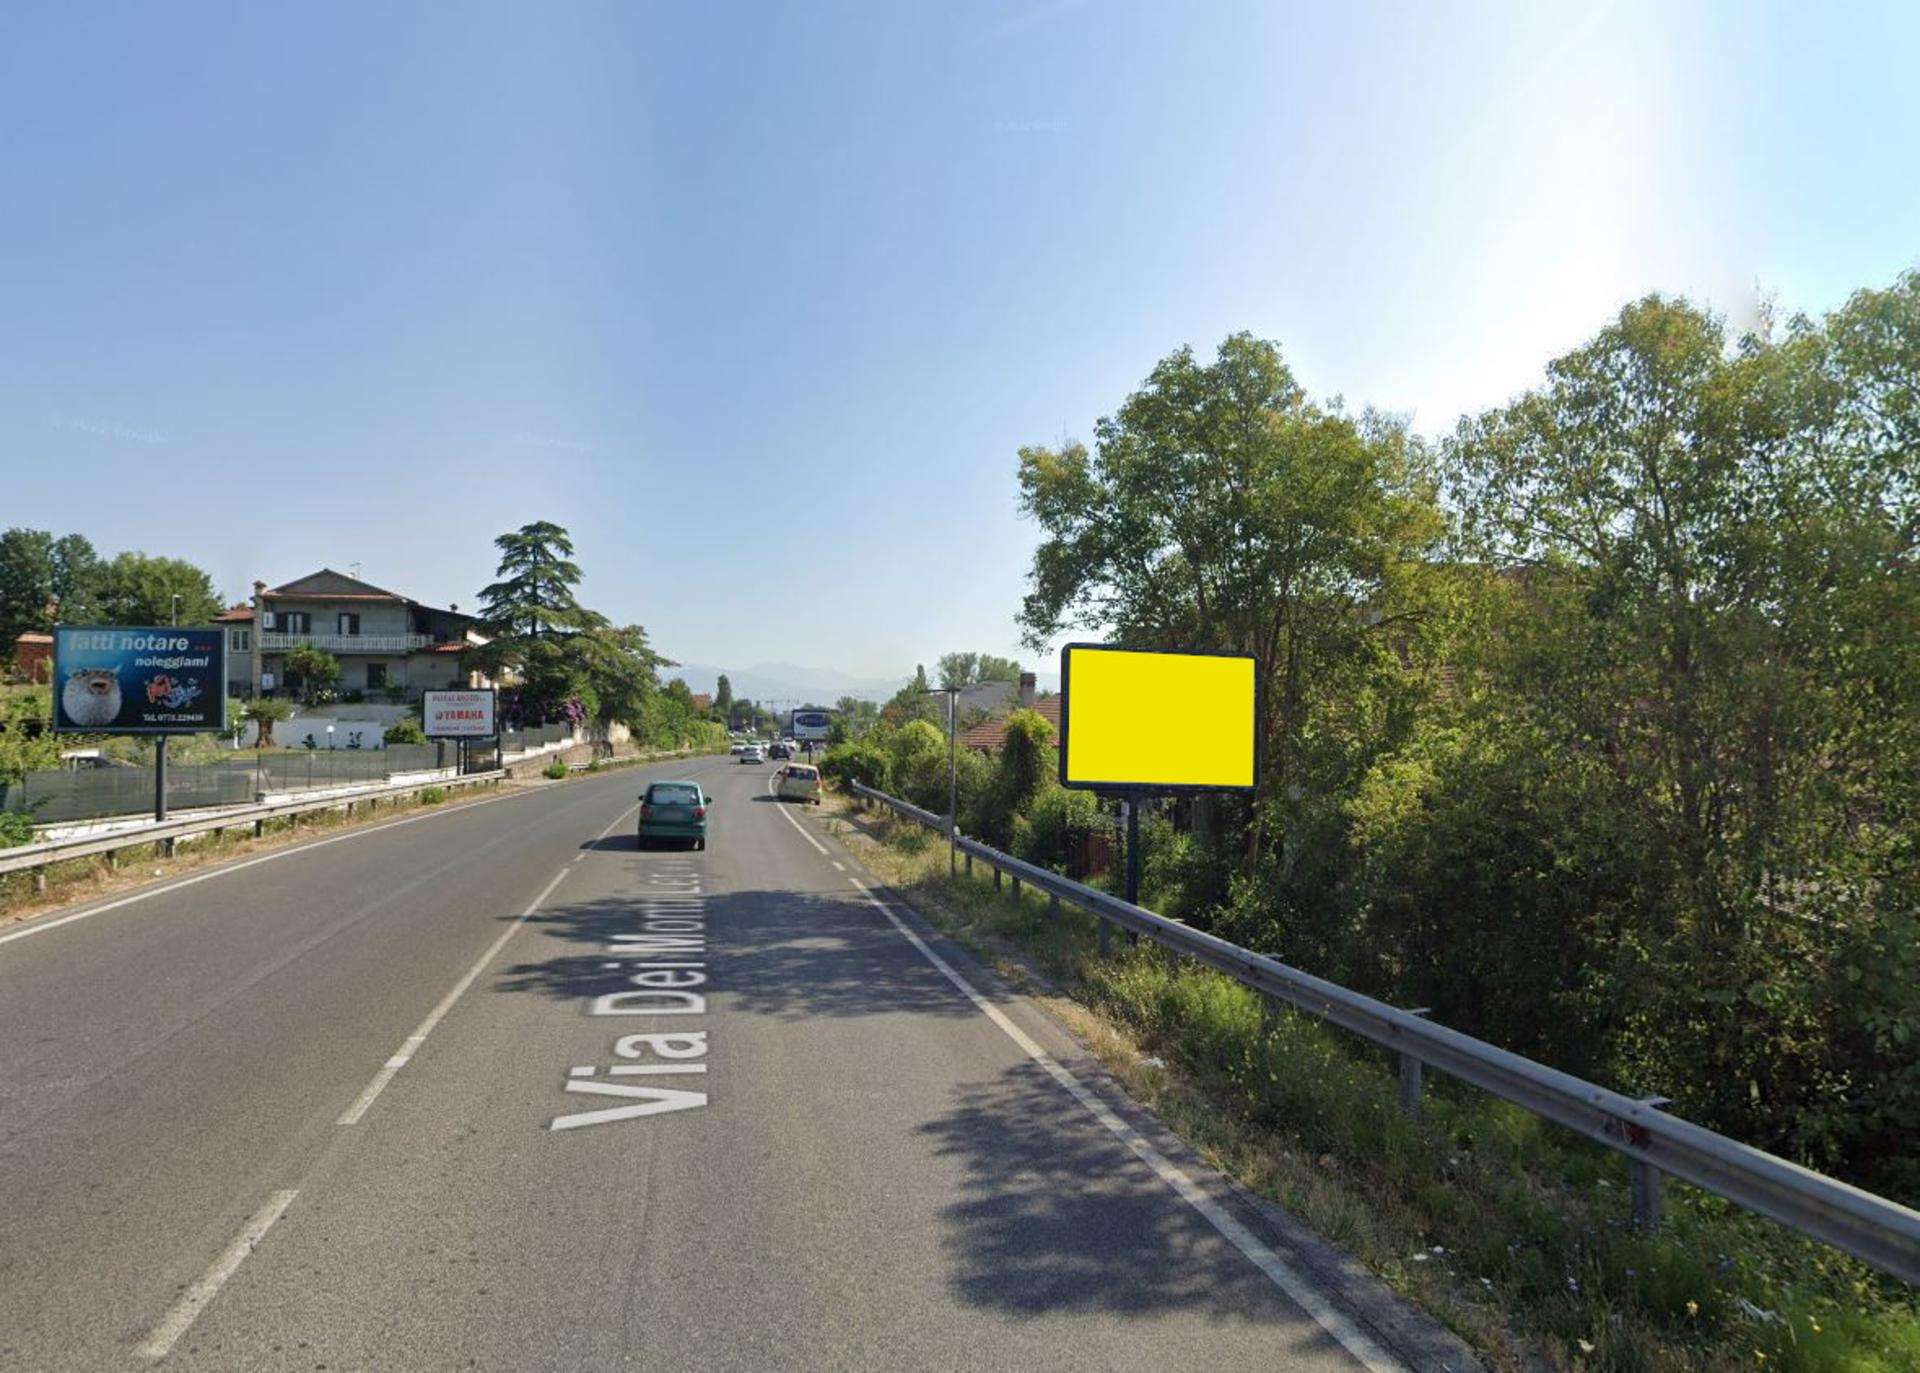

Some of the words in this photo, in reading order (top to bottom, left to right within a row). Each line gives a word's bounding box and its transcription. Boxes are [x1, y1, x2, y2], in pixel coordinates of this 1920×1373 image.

[120, 634, 189, 652] notare
[135, 656, 208, 668] noleggiami
[445, 710, 484, 720] YAMAHA
